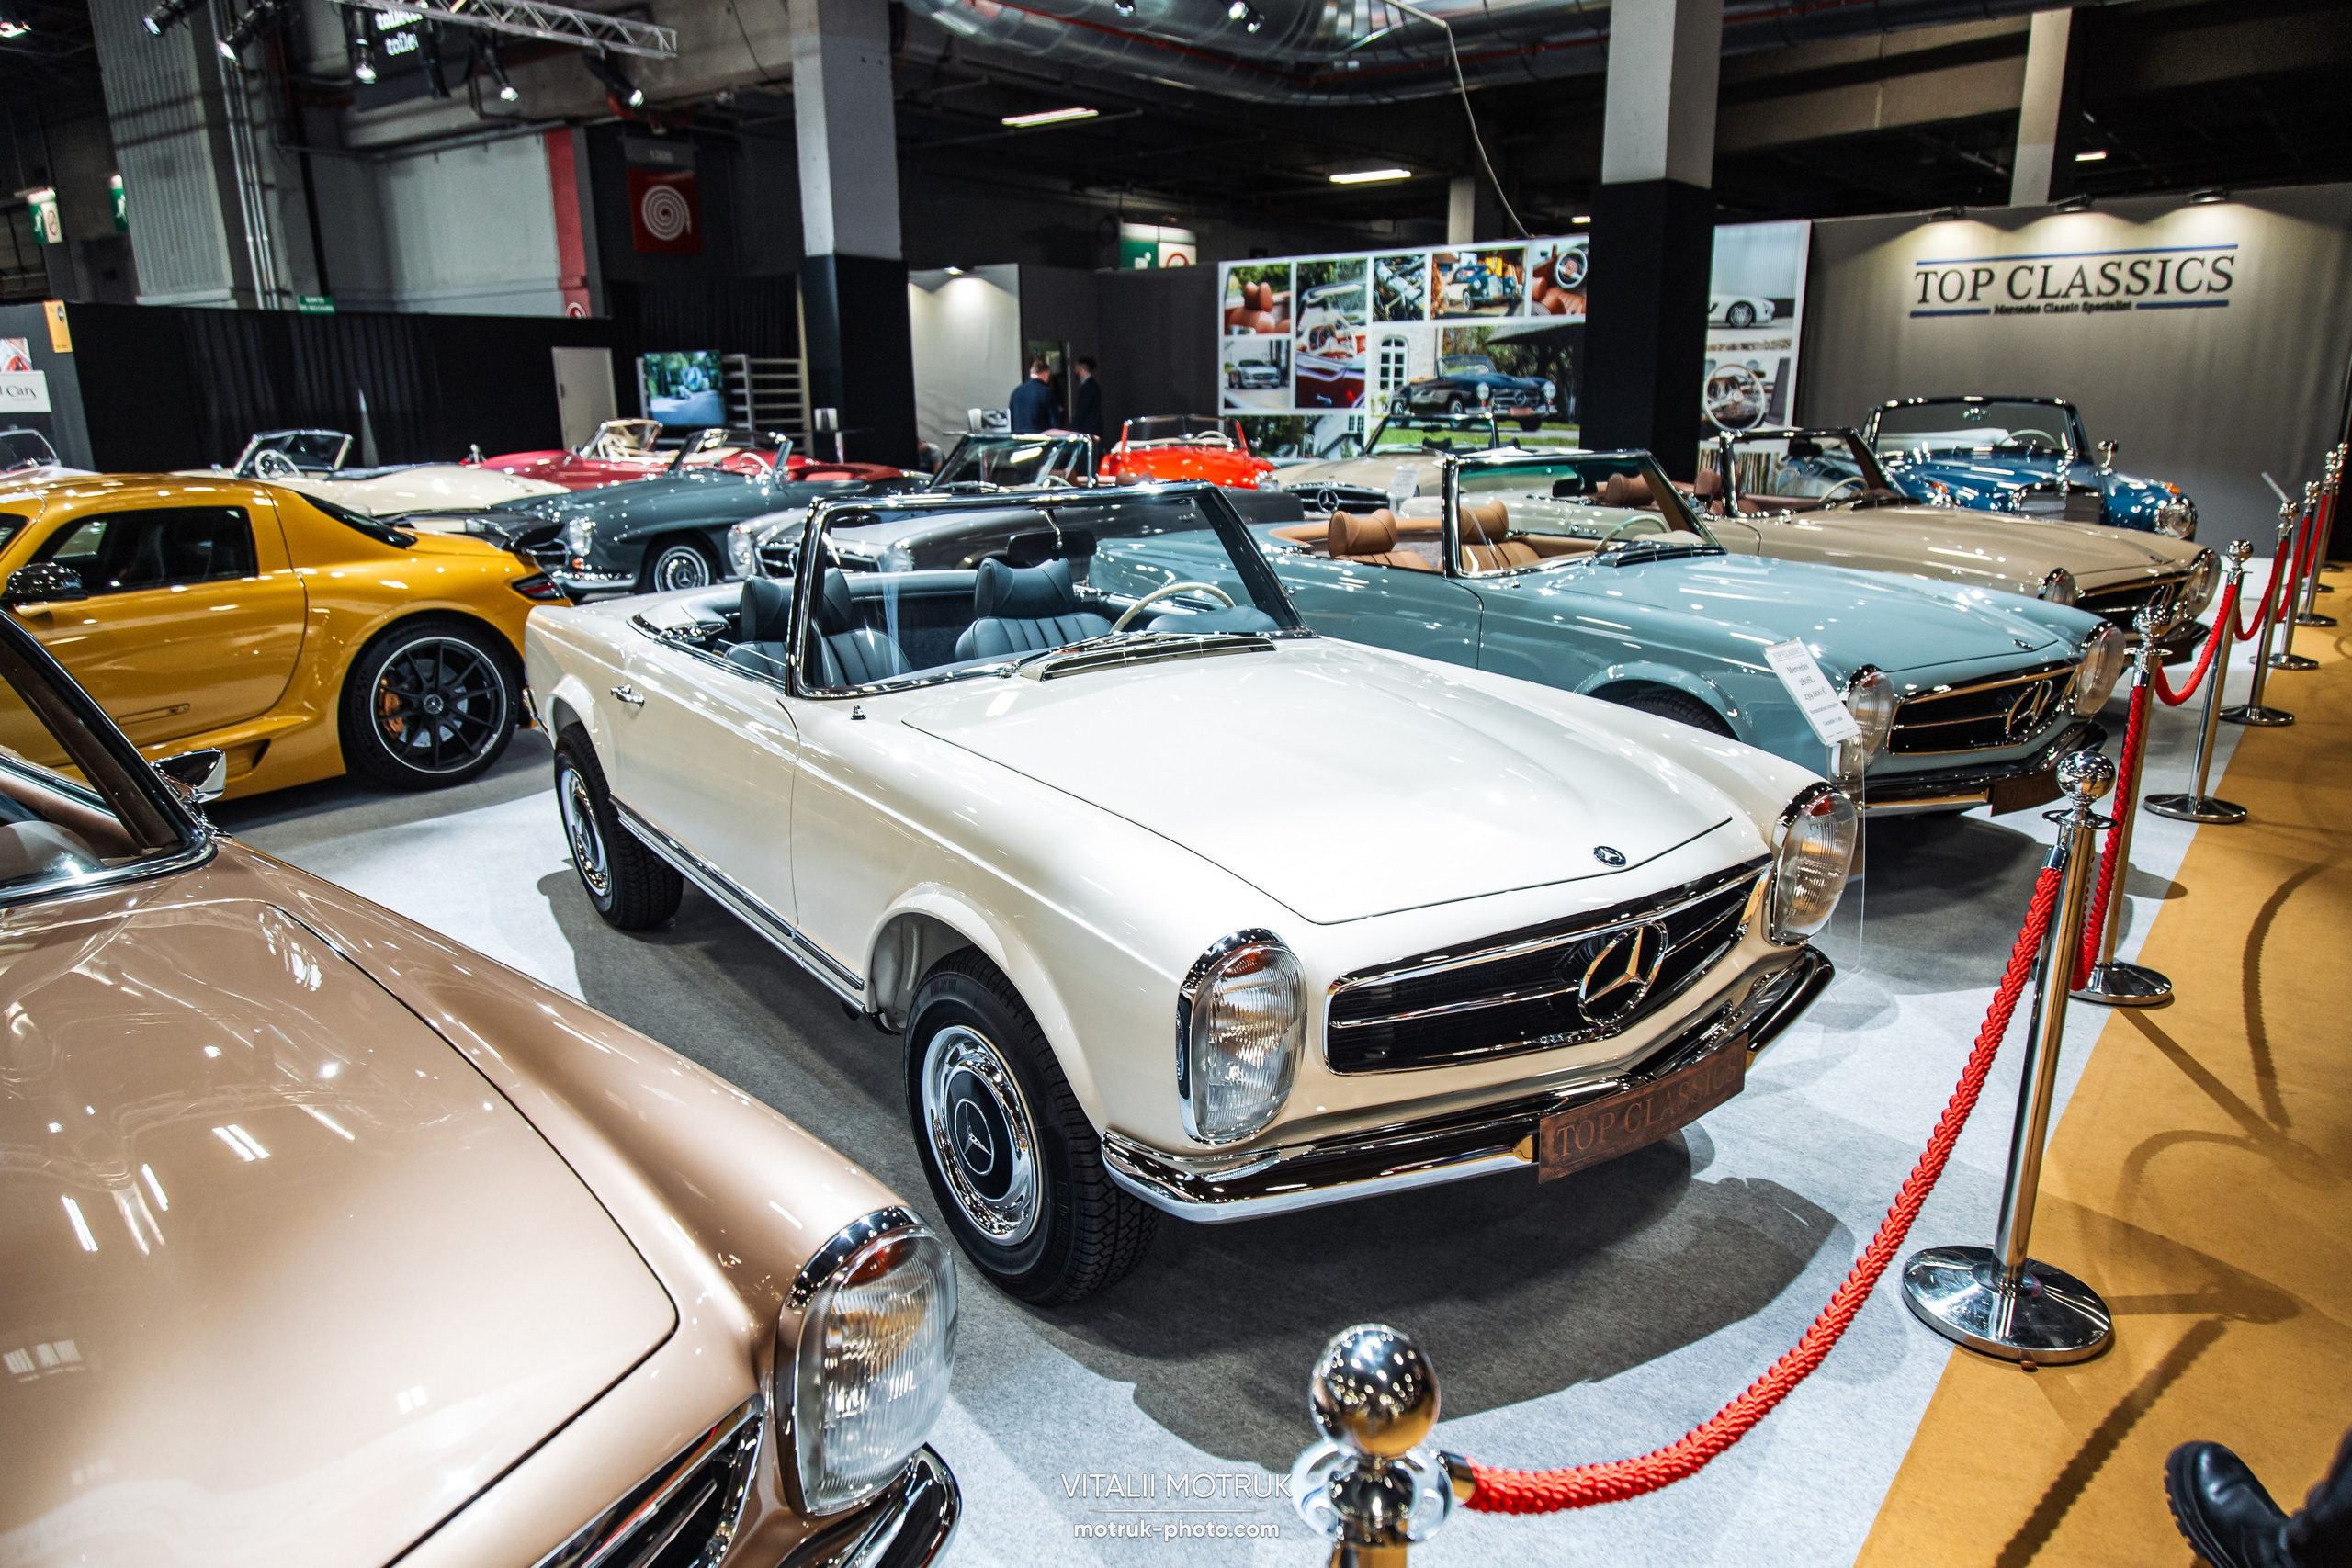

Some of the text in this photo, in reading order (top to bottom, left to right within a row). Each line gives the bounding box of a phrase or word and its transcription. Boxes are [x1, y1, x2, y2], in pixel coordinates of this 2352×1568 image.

[1915, 255, 2234, 304] TOP CLASSICS
[2043, 301, 2079, 313] Classic
[1556, 1111, 1616, 1157] TOP
[1623, 1061, 1738, 1134] CLASSICS
